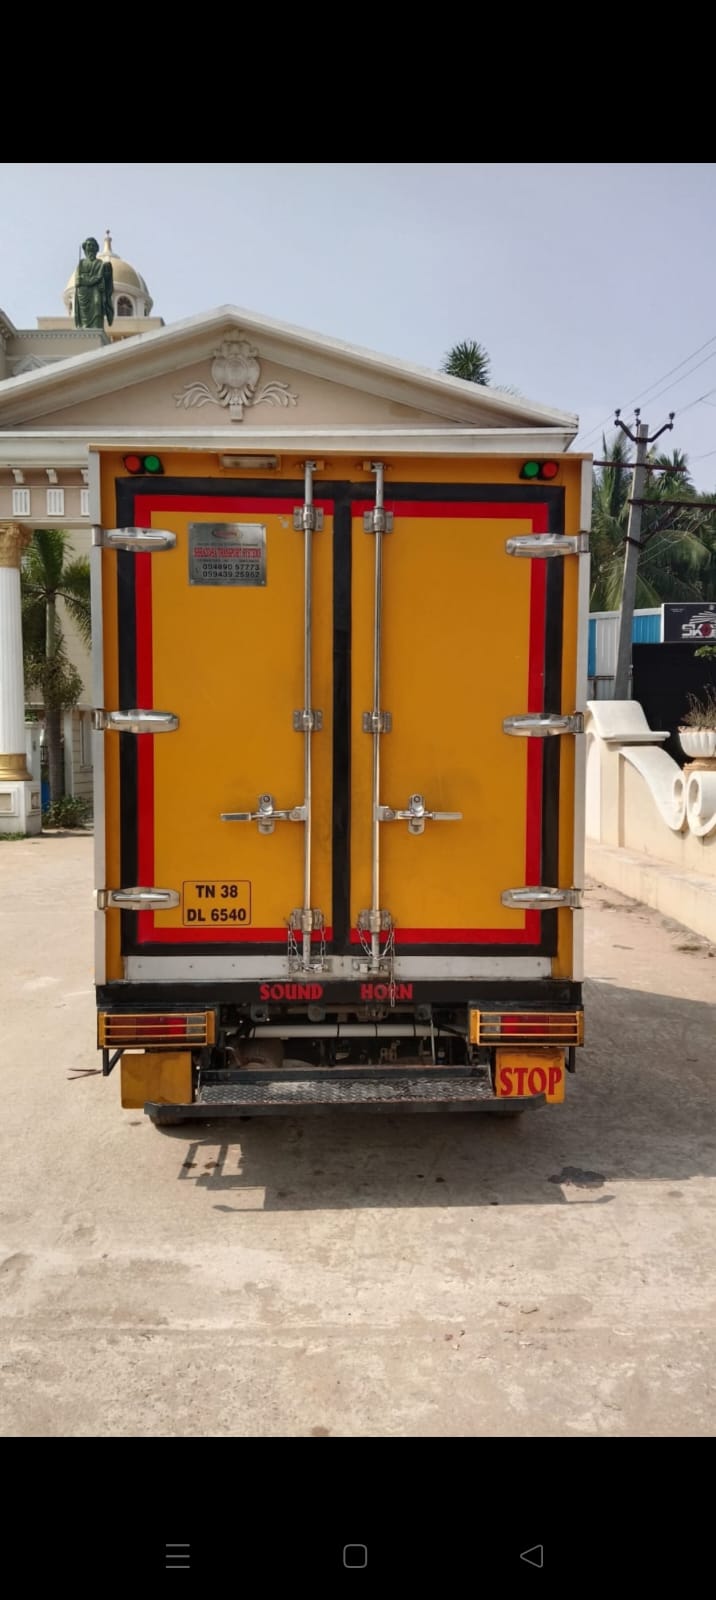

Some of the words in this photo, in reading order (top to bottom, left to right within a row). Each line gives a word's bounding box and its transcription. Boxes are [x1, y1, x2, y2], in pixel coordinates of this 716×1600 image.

[196, 885, 215, 898] TN
[220, 885, 239, 898] 38
[187, 908, 206, 922] DL
[211, 908, 247, 922] 6540
[259, 983, 323, 1000] SOUND
[360, 983, 413, 1000] HORN
[500, 1067, 562, 1096] STOP
